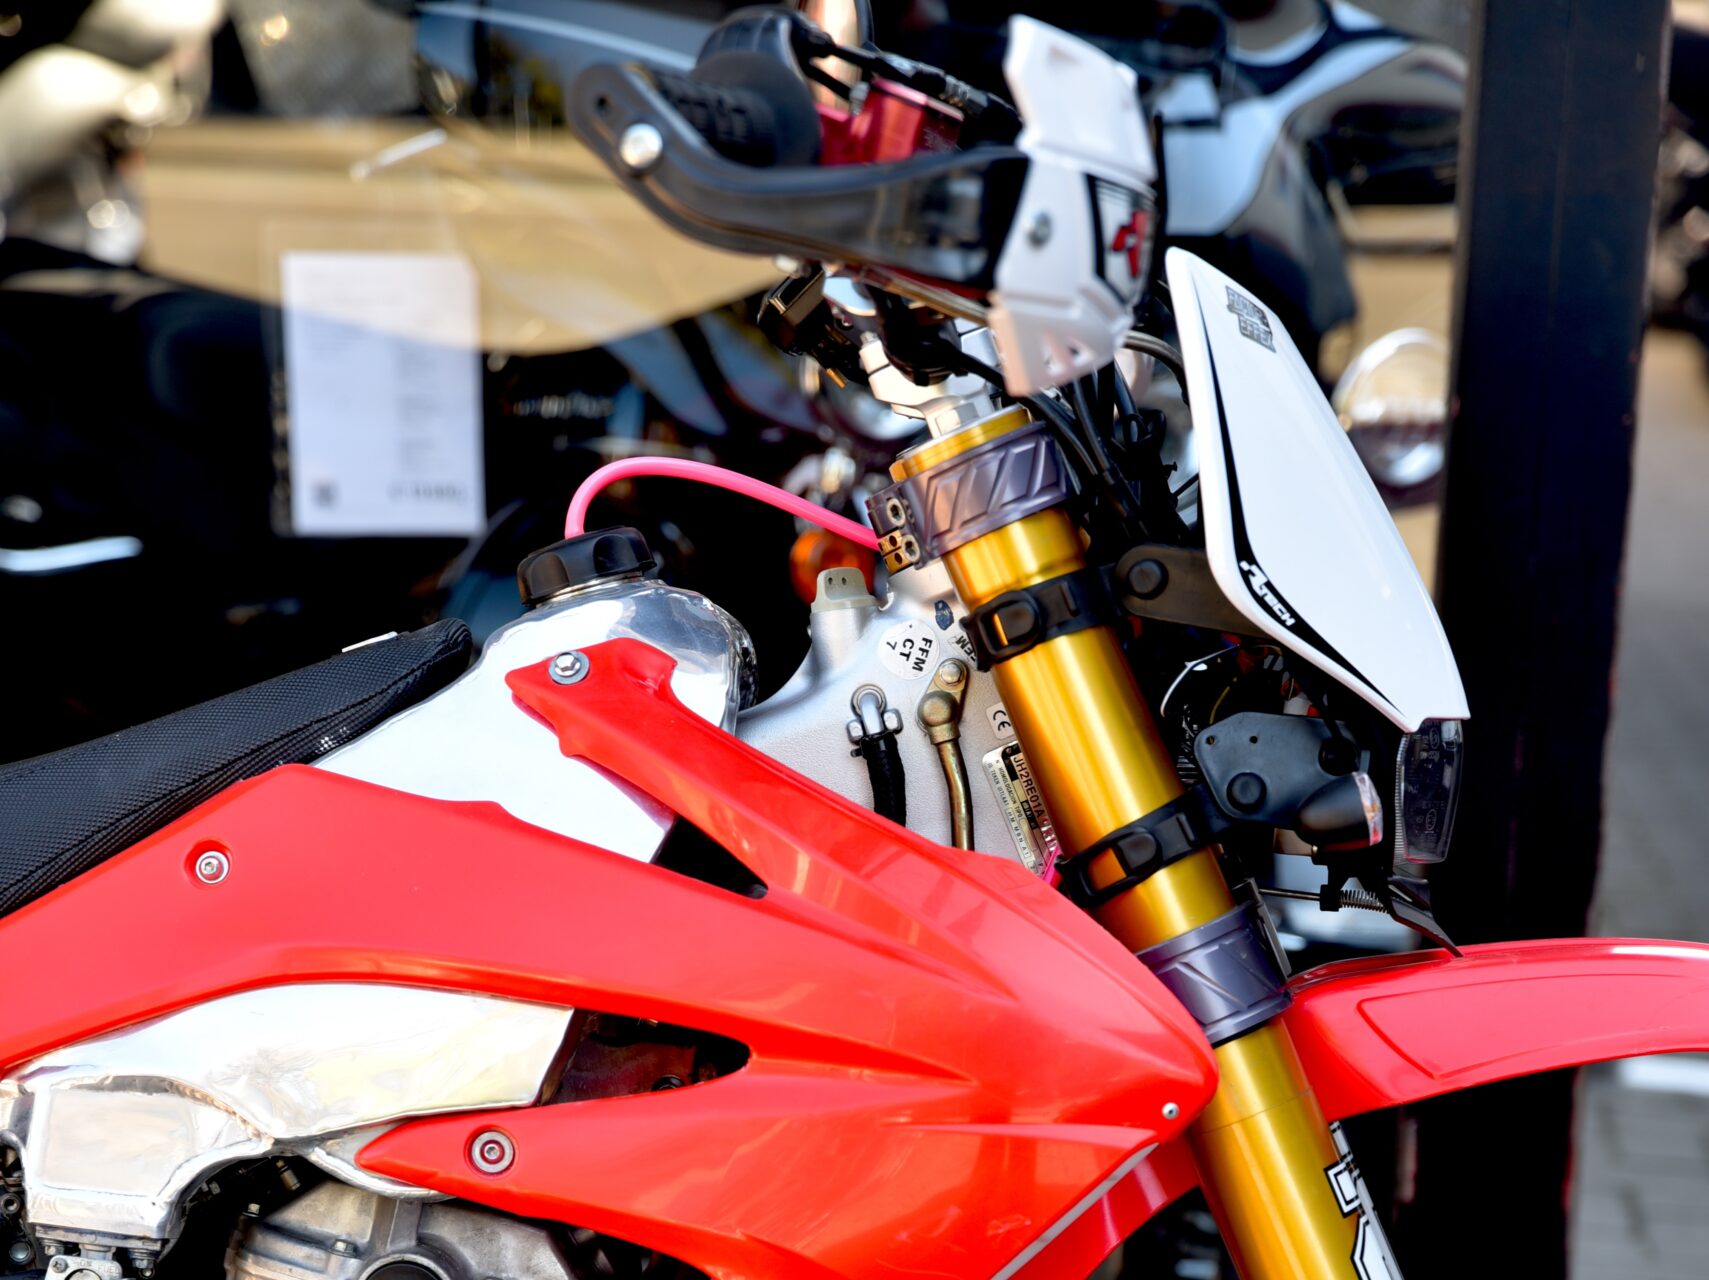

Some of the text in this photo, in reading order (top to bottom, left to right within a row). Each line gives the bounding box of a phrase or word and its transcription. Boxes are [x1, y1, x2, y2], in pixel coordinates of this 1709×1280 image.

[886, 640, 898, 650] 7
[899, 638, 914, 662] CT
[911, 637, 933, 672] FFM
